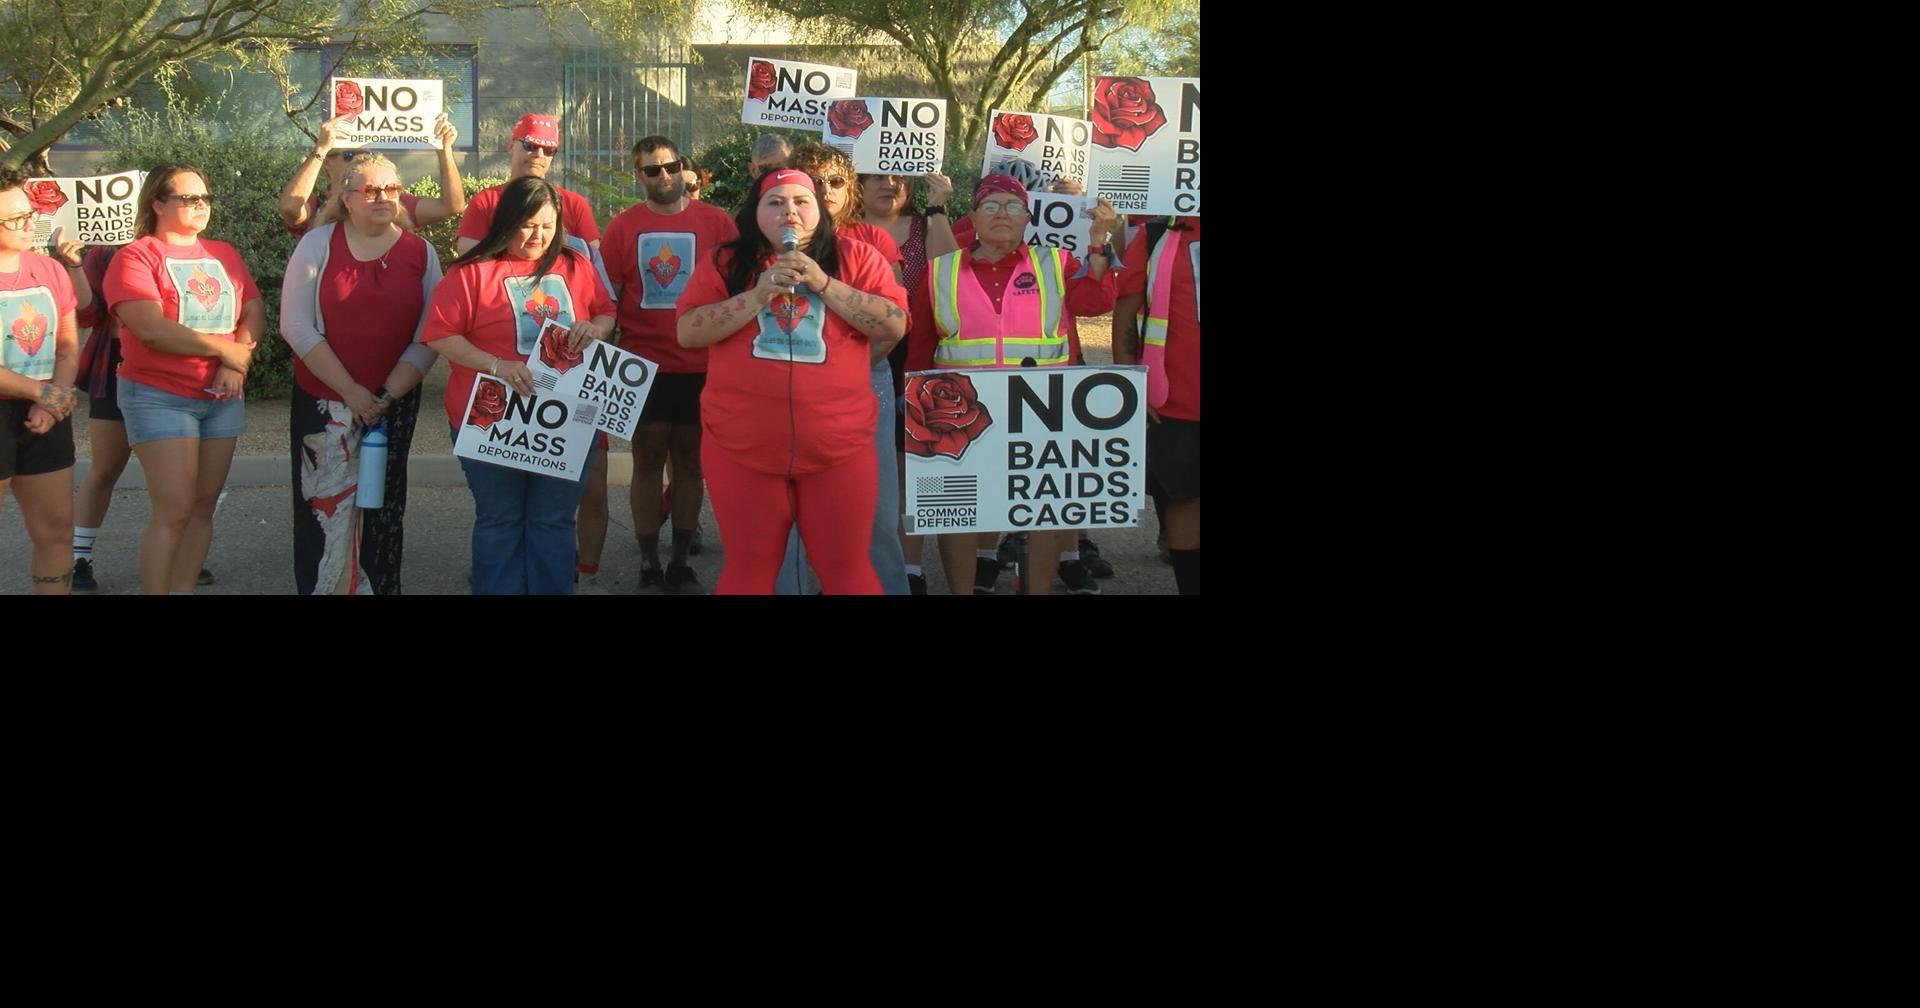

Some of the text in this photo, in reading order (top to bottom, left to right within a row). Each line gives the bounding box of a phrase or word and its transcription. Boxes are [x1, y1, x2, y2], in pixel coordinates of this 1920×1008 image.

[777, 67, 830, 96] NO
[365, 86, 418, 111] NO
[357, 116, 424, 132] MASS
[761, 113, 824, 126] DEPORTATIO
[881, 100, 940, 129] NO
[350, 134, 429, 144] DEPORTATIONS
[880, 131, 939, 147] BANS.
[1045, 117, 1089, 147] NO
[879, 146, 939, 161] RAIDS.
[878, 160, 938, 173] CAGES.
[76, 176, 133, 204] NO
[1097, 192, 1148, 201] COMMON
[1097, 201, 1147, 210] FENSE
[79, 217, 133, 231] RAIDS
[79, 230, 134, 242] CAGES
[1027, 232, 1077, 251] ASS
[588, 343, 648, 388] NO
[582, 374, 637, 409] BANS.
[1008, 372, 1138, 433] NO
[504, 391, 568, 429] NO
[597, 413, 627, 435] GES.
[488, 425, 566, 457] MASS
[478, 445, 567, 471] DEPORTATIONS
[1008, 437, 1138, 470] BANS.
[1008, 471, 1137, 500] RAIDS.
[917, 507, 977, 518] COMMON
[917, 517, 977, 527] DEFENSE
[1008, 501, 1137, 527] CAGES.
